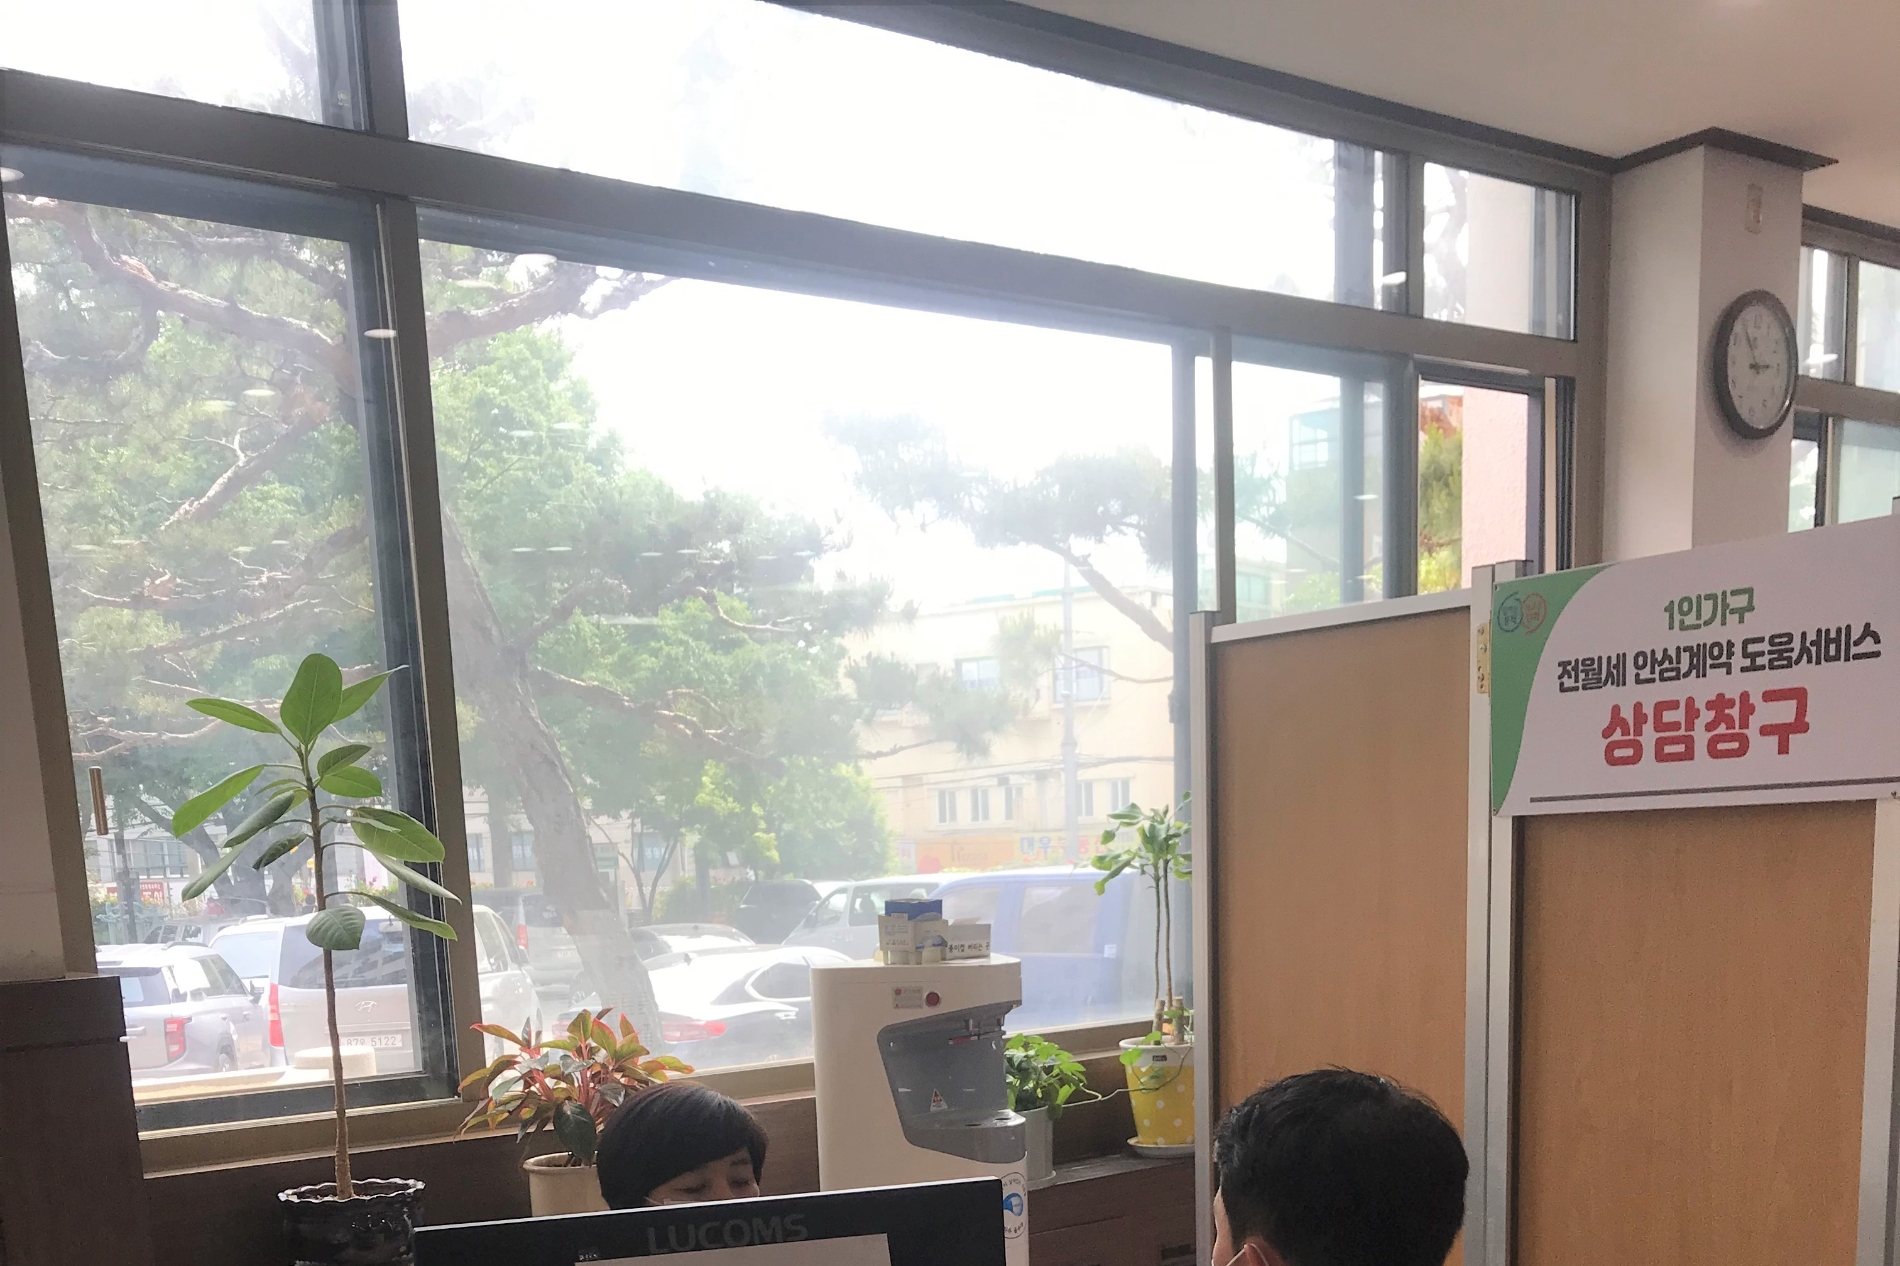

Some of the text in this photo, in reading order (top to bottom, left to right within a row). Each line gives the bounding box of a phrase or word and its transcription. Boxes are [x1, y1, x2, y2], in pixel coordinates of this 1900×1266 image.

[1664, 587, 1755, 631] 1인가구
[1557, 622, 1882, 693] 전월세 안심계약 도움서비스
[1601, 686, 1810, 766] 상담창구
[371, 1036, 397, 1047] 5122
[647, 1213, 808, 1254] LUCOMS
